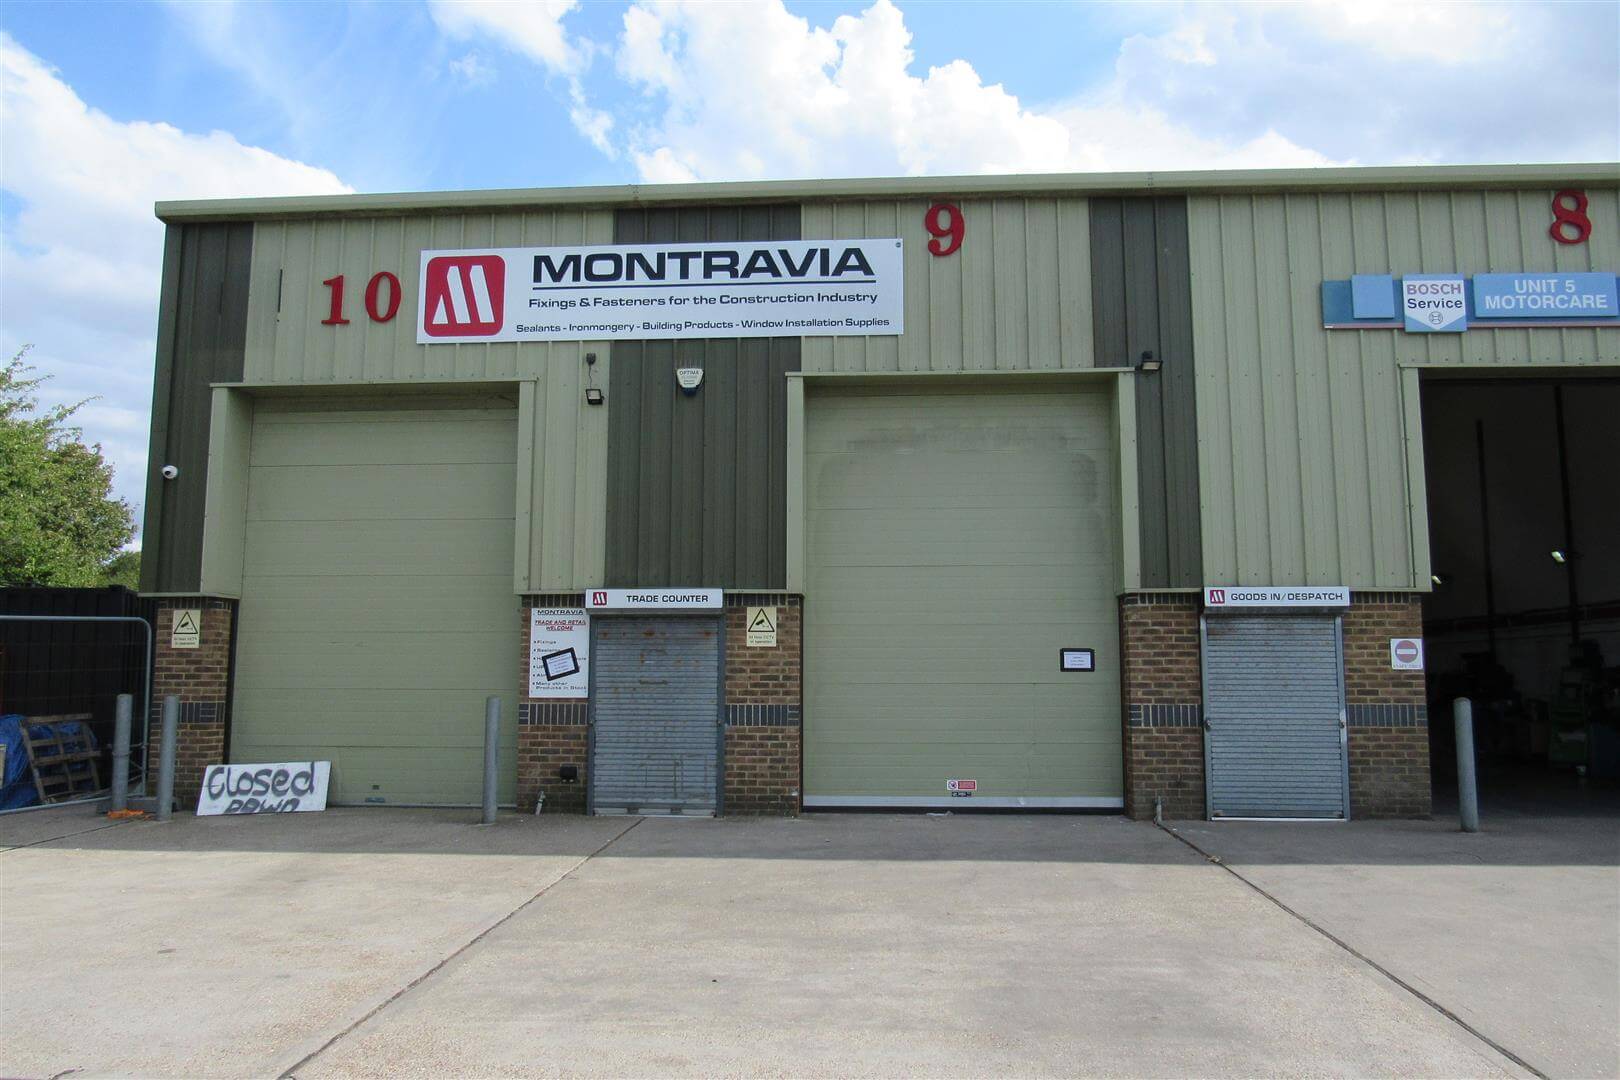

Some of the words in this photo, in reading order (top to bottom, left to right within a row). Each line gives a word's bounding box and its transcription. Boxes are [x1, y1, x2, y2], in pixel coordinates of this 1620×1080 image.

[1549, 188, 1592, 245] 8
[924, 202, 966, 257] 9
[533, 247, 875, 283] MONTRAVIA
[1407, 283, 1462, 295] BOSCH
[1514, 279, 1558, 293] UNIT
[1565, 279, 1576, 293] 5
[320, 271, 402, 326] 10
[529, 297, 576, 310] Fixings
[579, 297, 591, 307] &
[593, 295, 666, 307] Fasteners
[669, 295, 690, 306] for
[693, 294, 717, 306] the
[719, 293, 815, 305] Construction
[817, 291, 878, 304] Industry
[1407, 298, 1463, 309] Service
[1485, 294, 1609, 309] MOTORCARE
[516, 323, 561, 333] Sealants
[569, 322, 634, 334] Ironmongery
[643, 321, 682, 332] Building
[684, 320, 734, 330] Products
[741, 318, 784, 328] Window
[785, 317, 843, 328] Installation
[845, 317, 890, 328] Supplies
[626, 595, 659, 603] TRADE
[662, 595, 709, 603] COUNTER
[1230, 593, 1267, 601] GOODS
